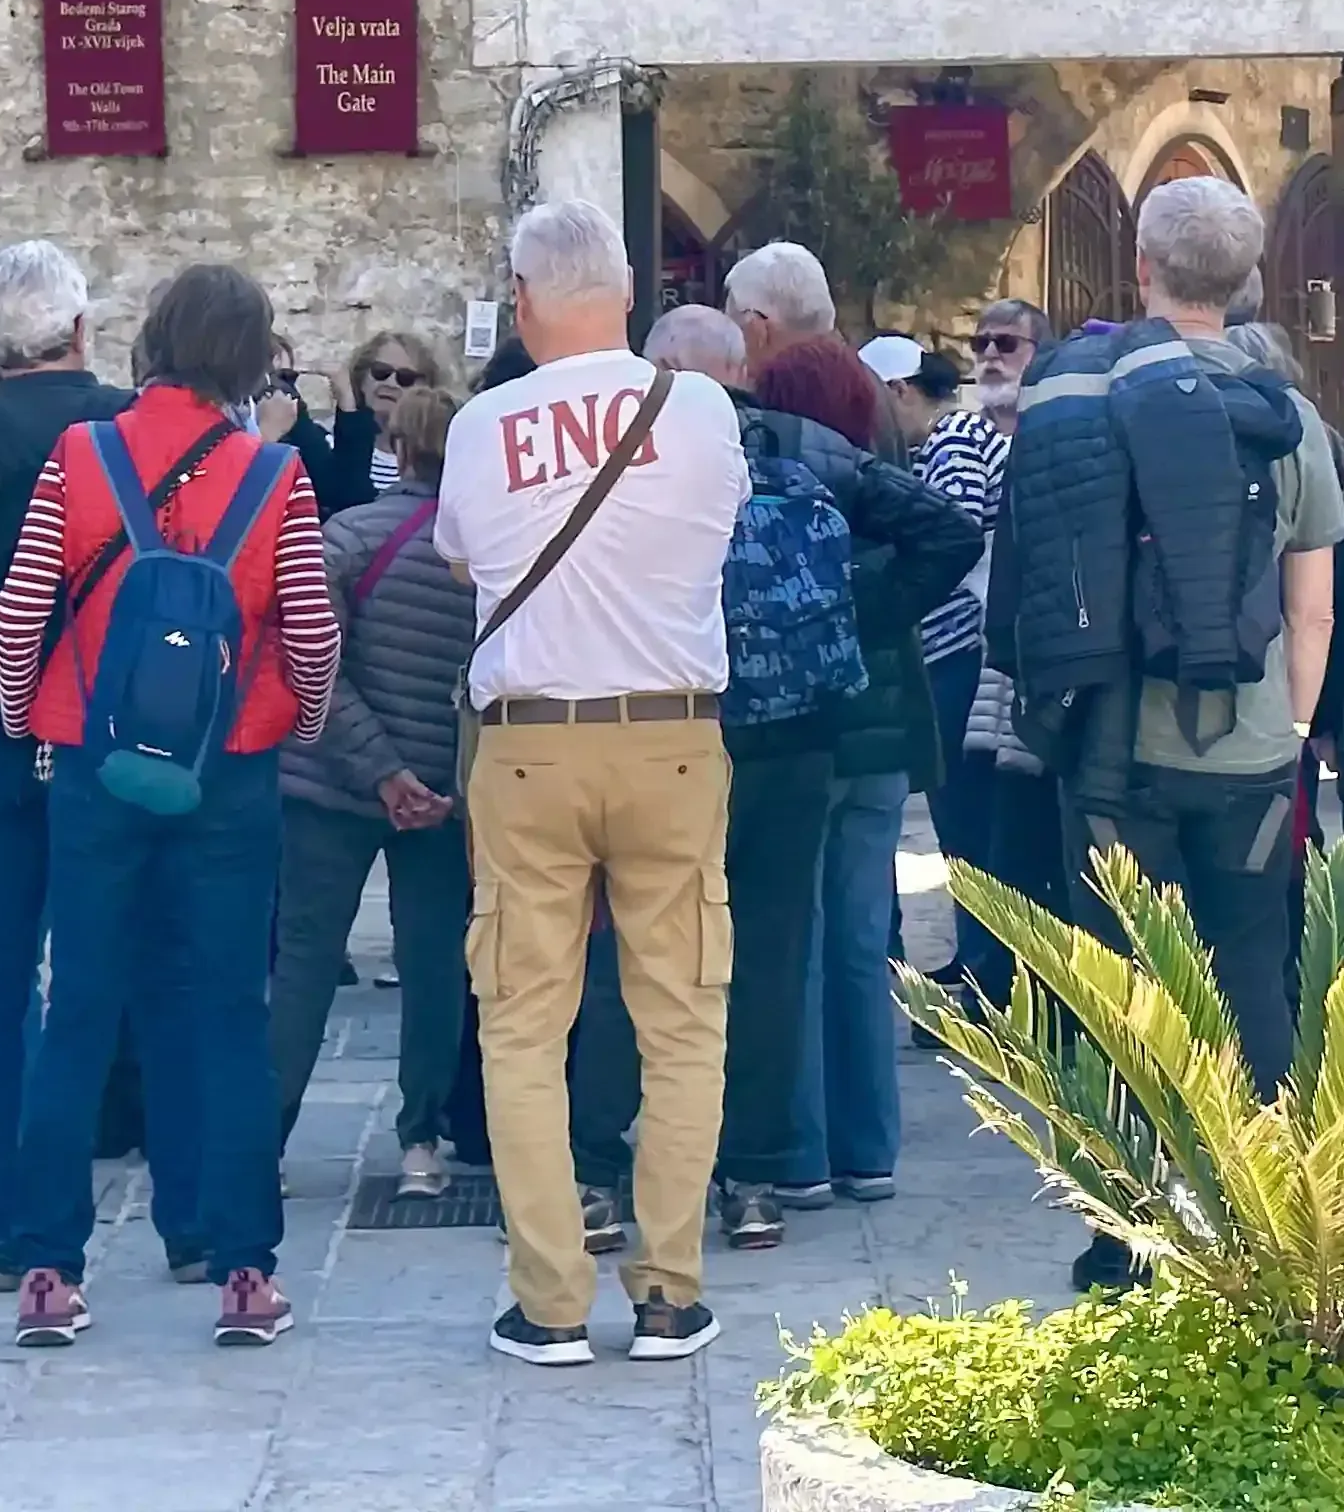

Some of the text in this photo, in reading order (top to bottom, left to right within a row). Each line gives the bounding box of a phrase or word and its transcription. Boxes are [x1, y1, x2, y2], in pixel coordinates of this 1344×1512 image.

[311, 15, 401, 44] Velja vrata
[315, 62, 396, 85] The Main
[67, 82, 89, 96] The
[337, 91, 377, 113] Gate
